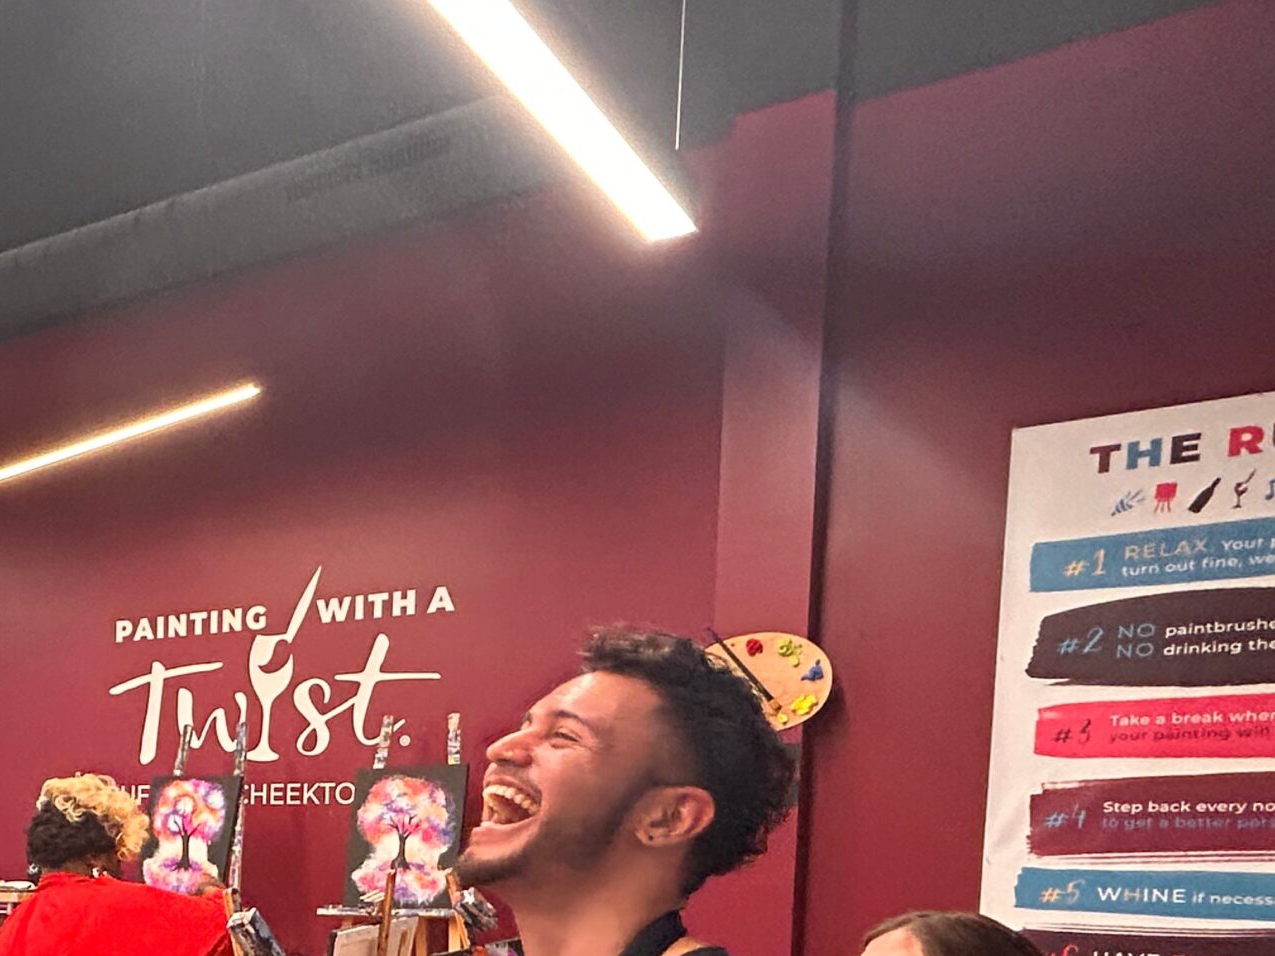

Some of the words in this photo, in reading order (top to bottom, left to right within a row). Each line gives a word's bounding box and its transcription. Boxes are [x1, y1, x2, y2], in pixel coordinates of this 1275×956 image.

[1089, 433, 1202, 474] THE
[1227, 422, 1275, 458] R
[1063, 548, 1107, 577] #1
[1121, 562, 1160, 576] turn
[1165, 560, 1195, 573] out
[114, 605, 268, 643] PAINTING
[316, 588, 417, 624] WITH
[426, 585, 456, 613] A
[1058, 626, 1104, 656] #2
[1118, 623, 1156, 639] NO
[1116, 642, 1155, 659] NO
[1163, 639, 1243, 656] drinking
[1109, 714, 1150, 727] Take
[1155, 716, 1169, 726] a
[1171, 711, 1224, 725] break
[1109, 729, 1148, 744] your
[1152, 727, 1231, 742] painting
[243, 782, 356, 806] HEEKTO
[1043, 802, 1087, 829] #4
[1102, 800, 1144, 815] Step
[1147, 800, 1191, 813] back
[1195, 801, 1248, 815] every
[1101, 816, 1118, 828] to
[1124, 817, 1152, 830] get
[1175, 816, 1230, 828] better
[1040, 878, 1086, 906] #5
[1096, 886, 1187, 904] WHINE
[1192, 891, 1207, 905] if
[1209, 894, 1275, 907] necess
